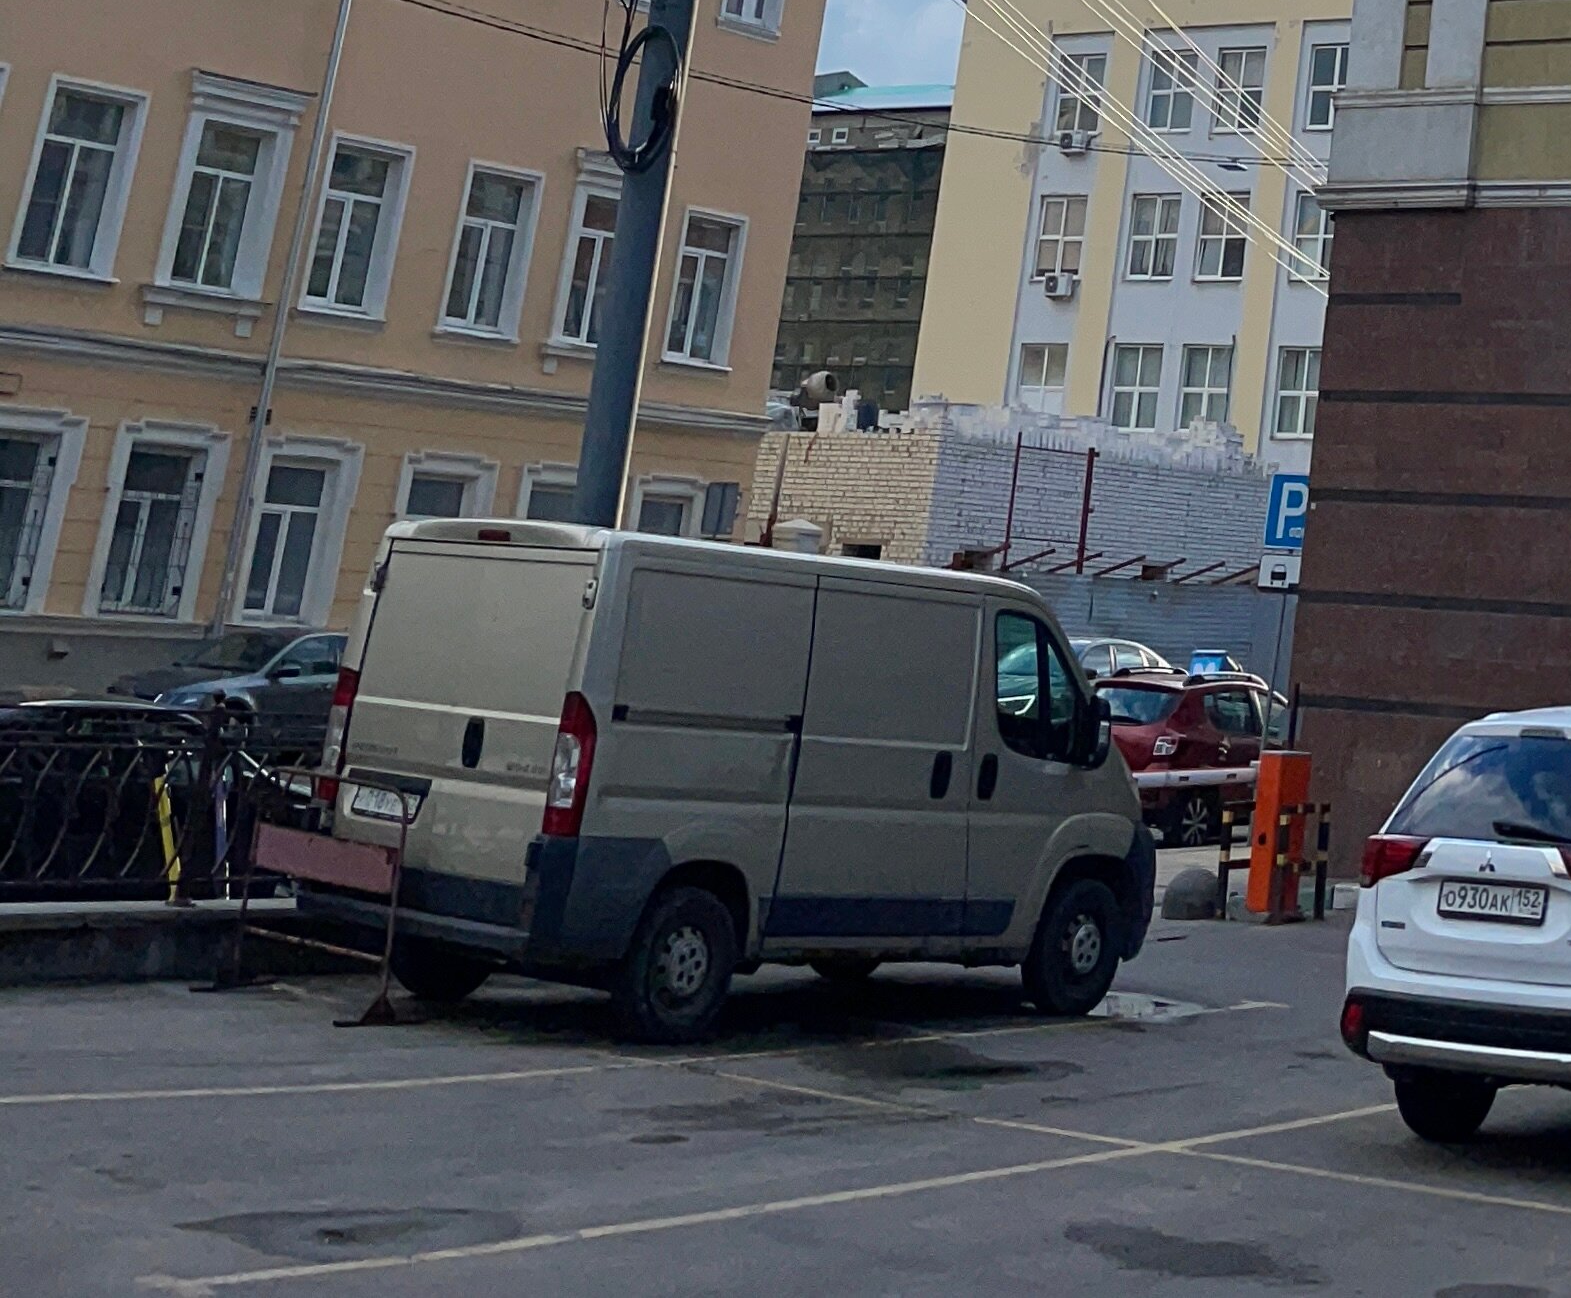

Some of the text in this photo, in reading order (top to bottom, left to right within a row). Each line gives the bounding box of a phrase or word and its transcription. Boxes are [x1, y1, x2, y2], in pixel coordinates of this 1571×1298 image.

[1276, 482, 1309, 539] P
[1444, 887, 1540, 912] О930АК 152
